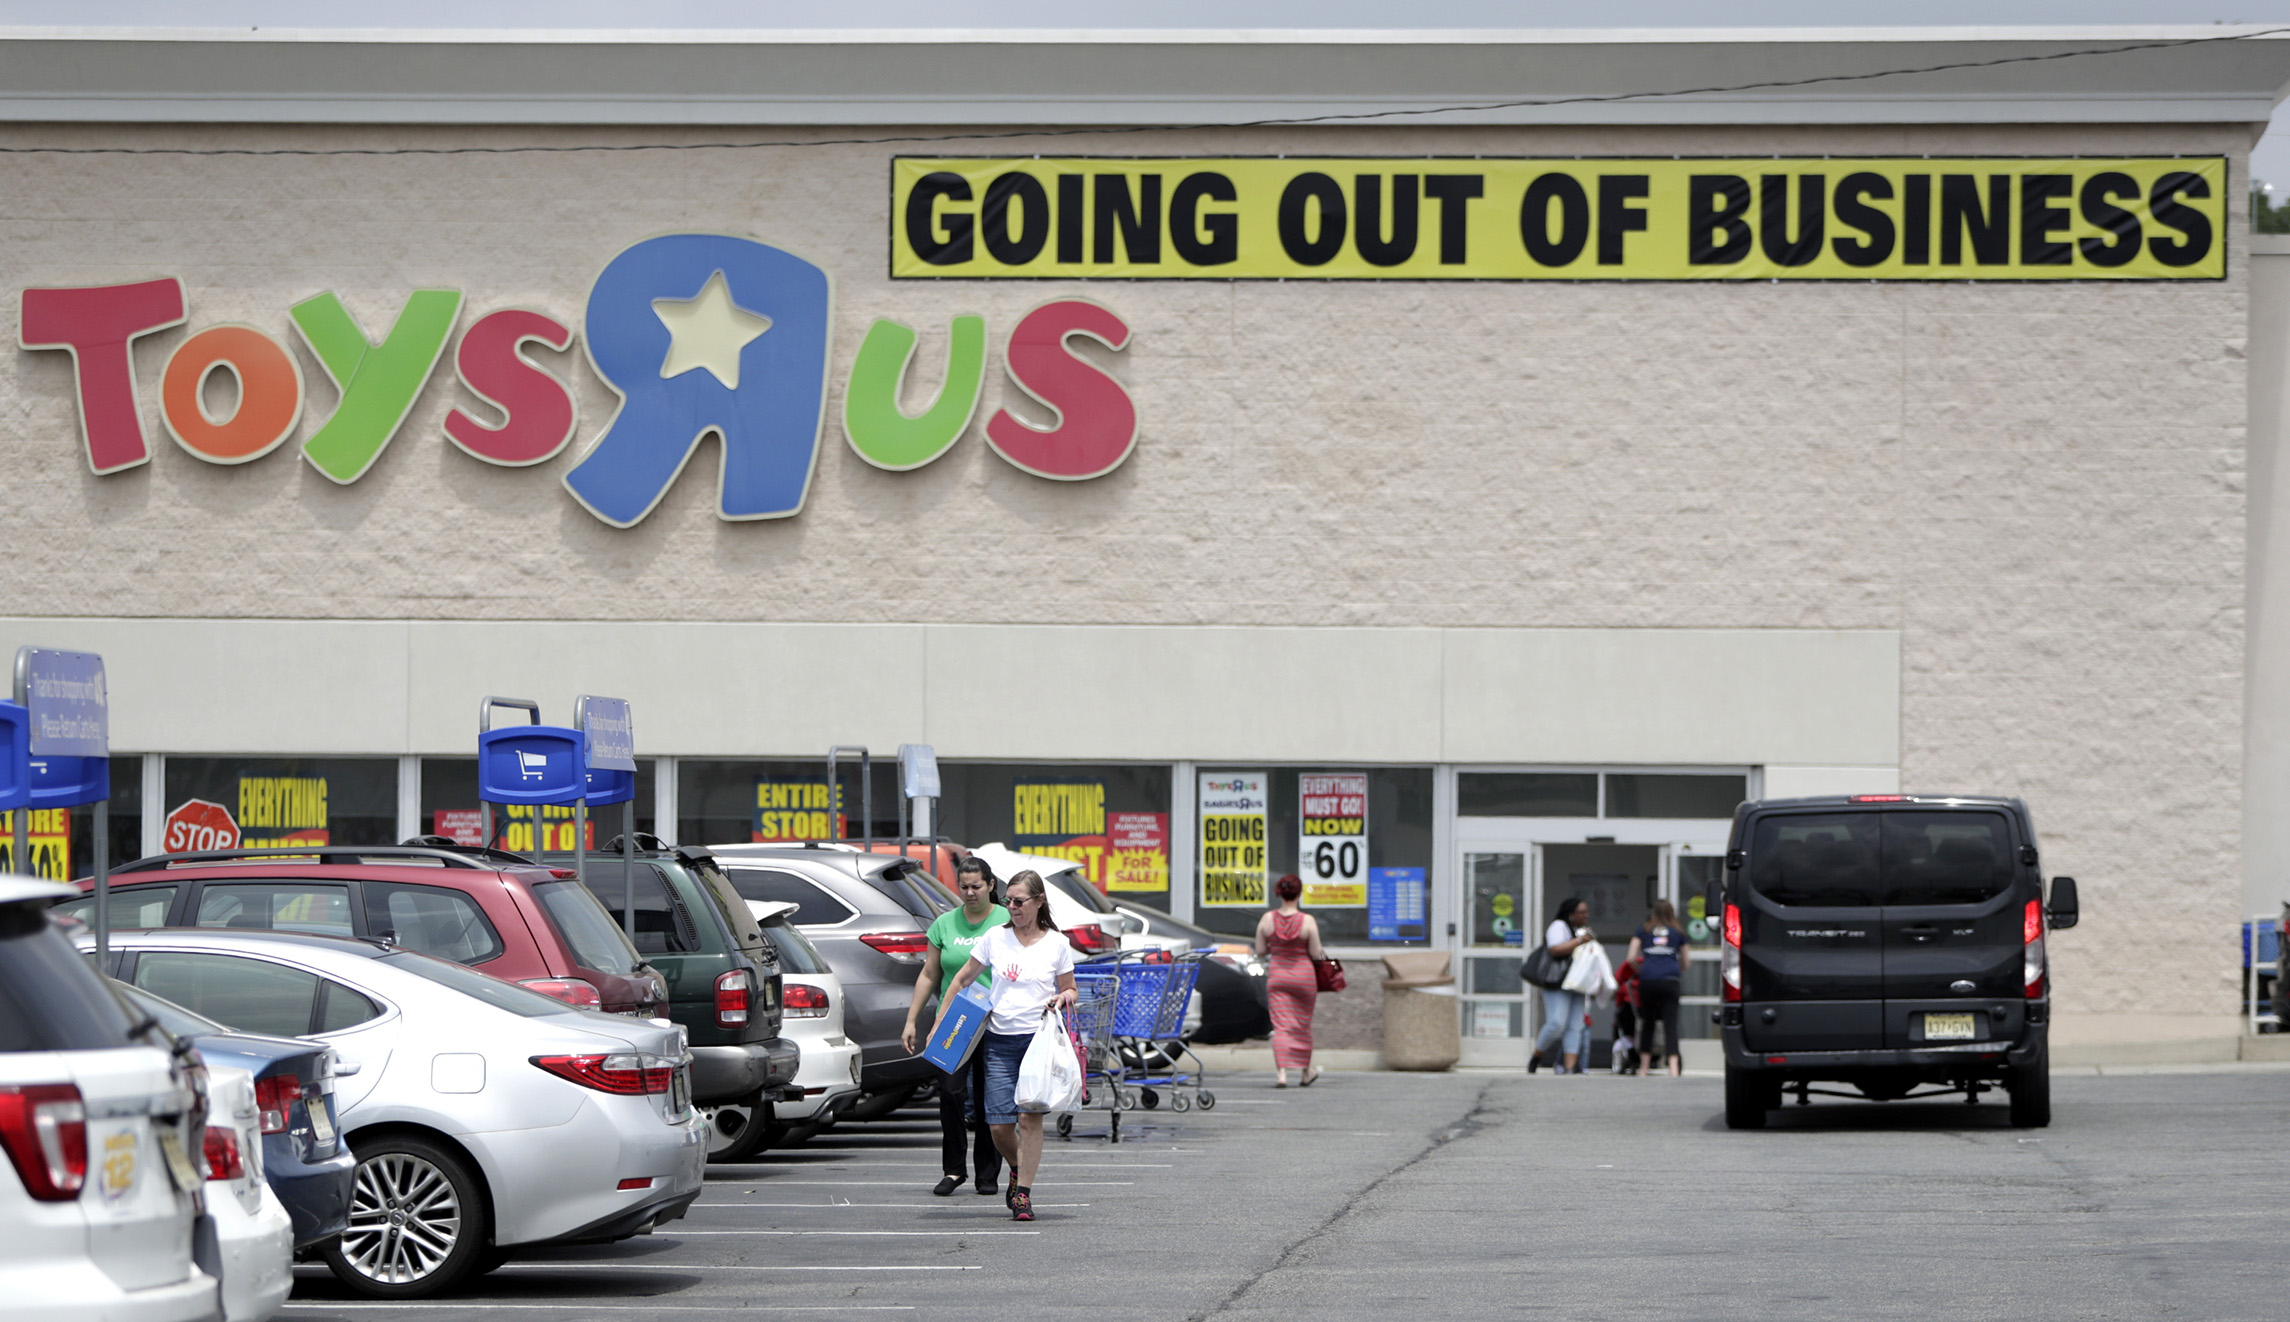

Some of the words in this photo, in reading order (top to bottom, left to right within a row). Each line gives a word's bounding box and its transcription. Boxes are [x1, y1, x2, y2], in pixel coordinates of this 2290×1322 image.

[906, 172, 1238, 267] GOING
[1278, 173, 1484, 267] OUT
[1519, 173, 1649, 267] OF
[1687, 172, 2213, 267] BUSINESS
[757, 784, 844, 809] ENTIRE
[1302, 778, 1364, 794] EVERYTHING
[239, 777, 328, 828] EVERYTHING
[1014, 783, 1105, 835] EVERYTHING
[1305, 797, 1338, 815] MUST
[1341, 797, 1363, 815] GO!
[169, 820, 233, 851] STOP
[507, 822, 555, 851] OUT
[762, 811, 842, 839] STORE
[1205, 818, 1263, 841] GOING
[1304, 818, 1362, 835] NOW
[1019, 846, 1104, 883] ST
[1122, 857, 1152, 869] FOR
[1205, 847, 1238, 868] OUT
[1244, 847, 1264, 868] OF
[1115, 871, 1159, 883] SALE!
[1206, 873, 1264, 901] BUSINESS
[104, 1153, 133, 1188] 12
